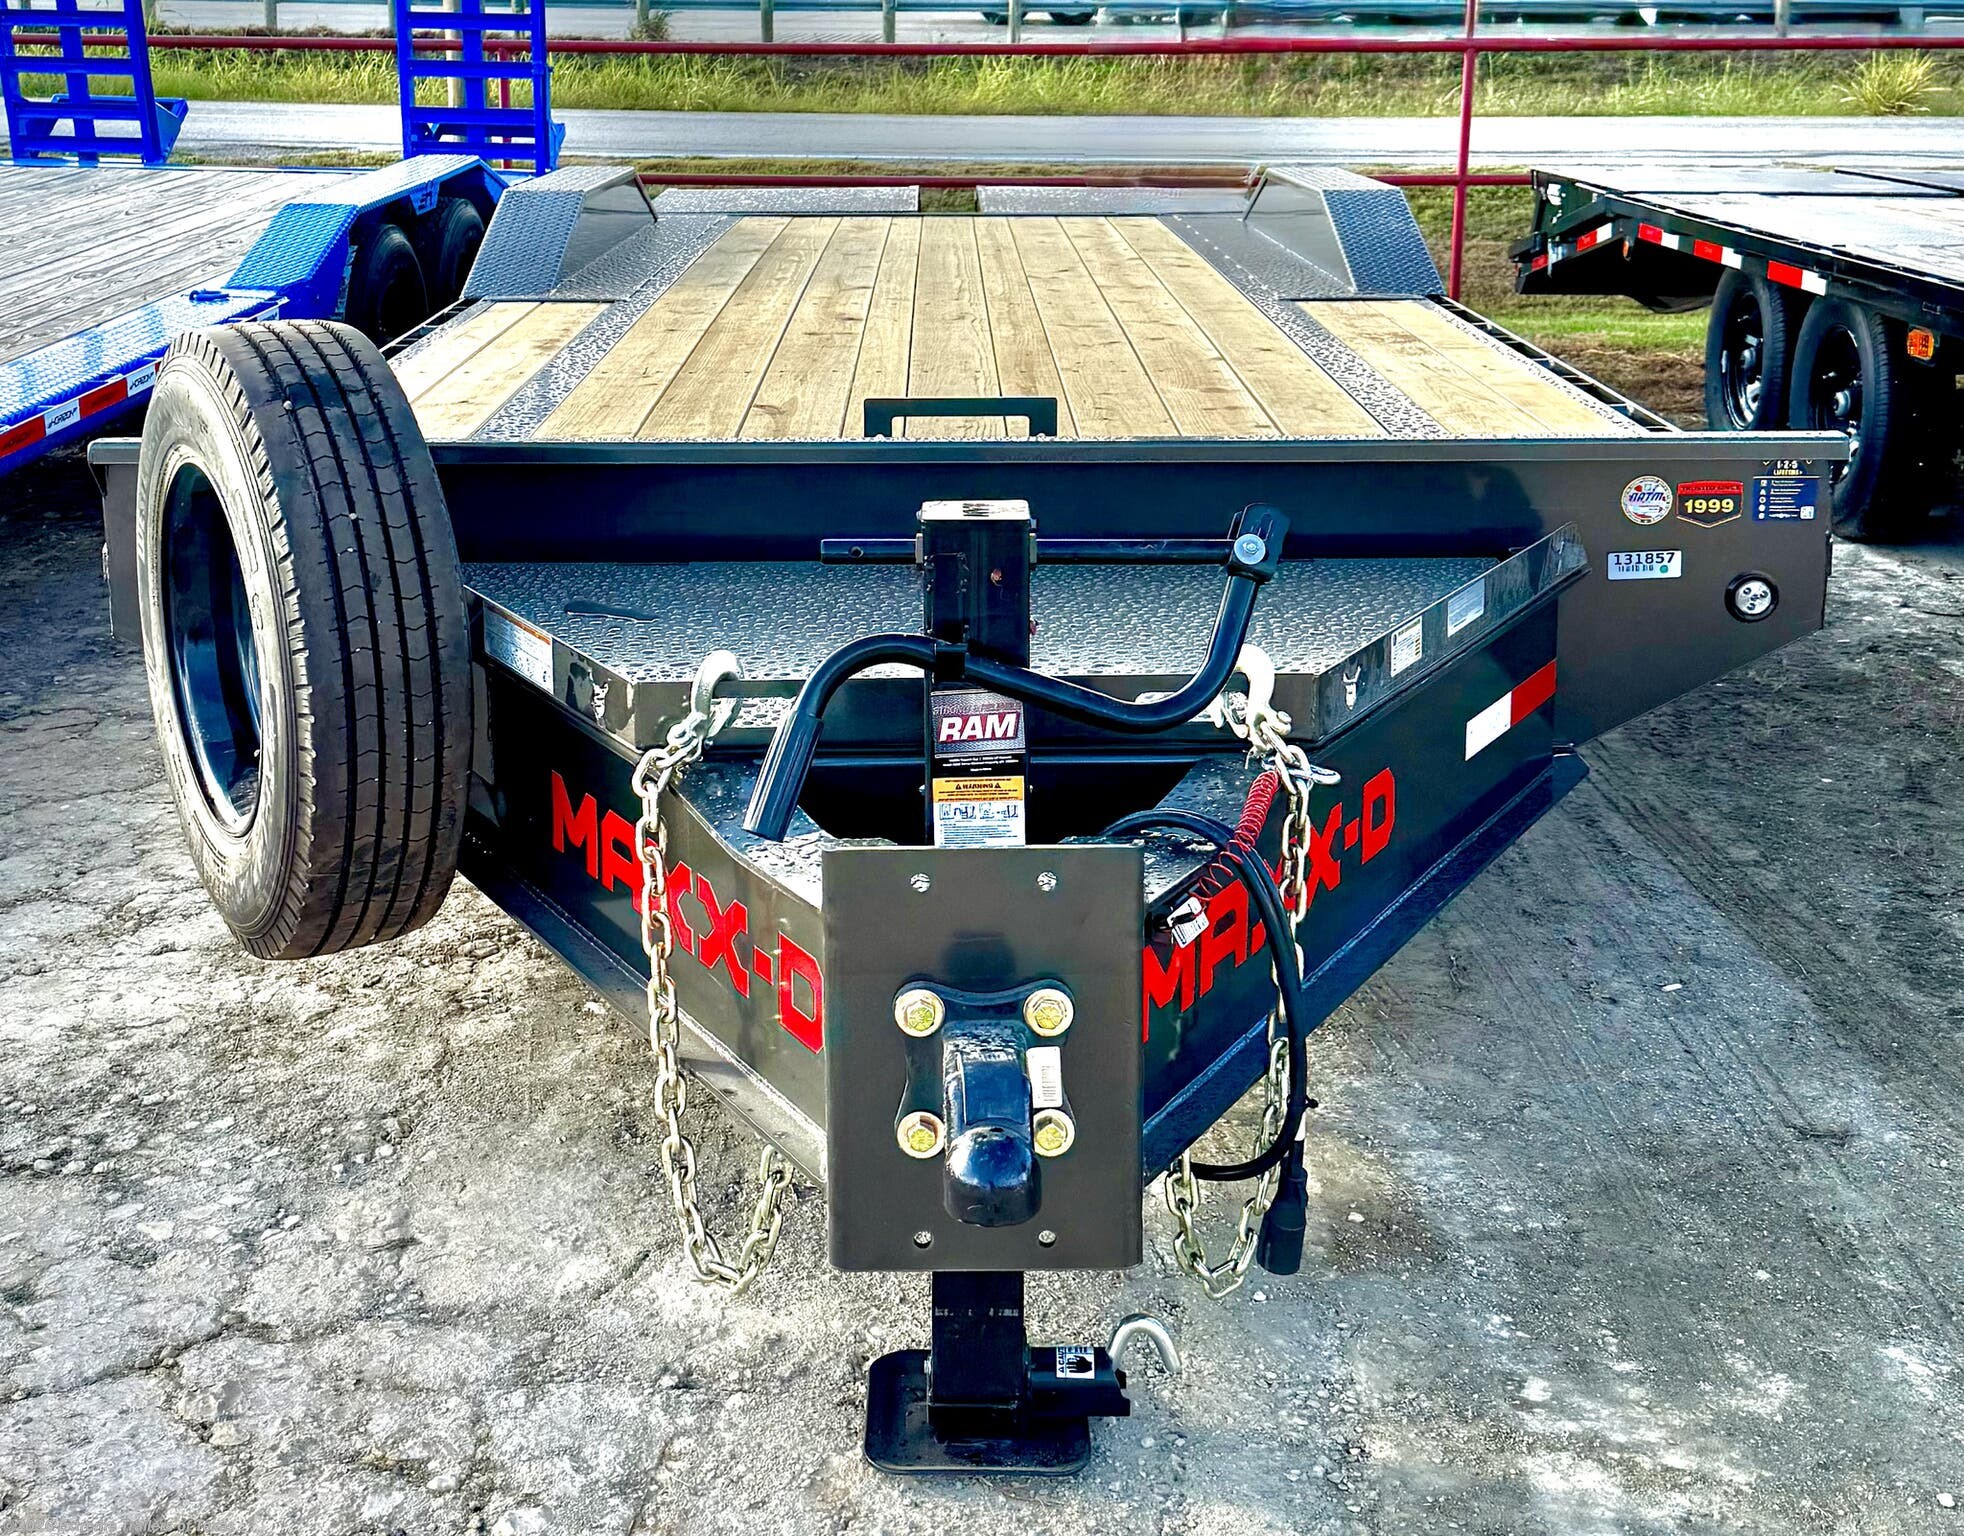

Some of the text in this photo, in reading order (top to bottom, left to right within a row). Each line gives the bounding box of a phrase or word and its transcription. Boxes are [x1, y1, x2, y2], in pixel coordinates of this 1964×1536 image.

[1684, 498, 1735, 514] 1999
[1614, 552, 1676, 566] 131857
[939, 713, 1018, 742] RAM
